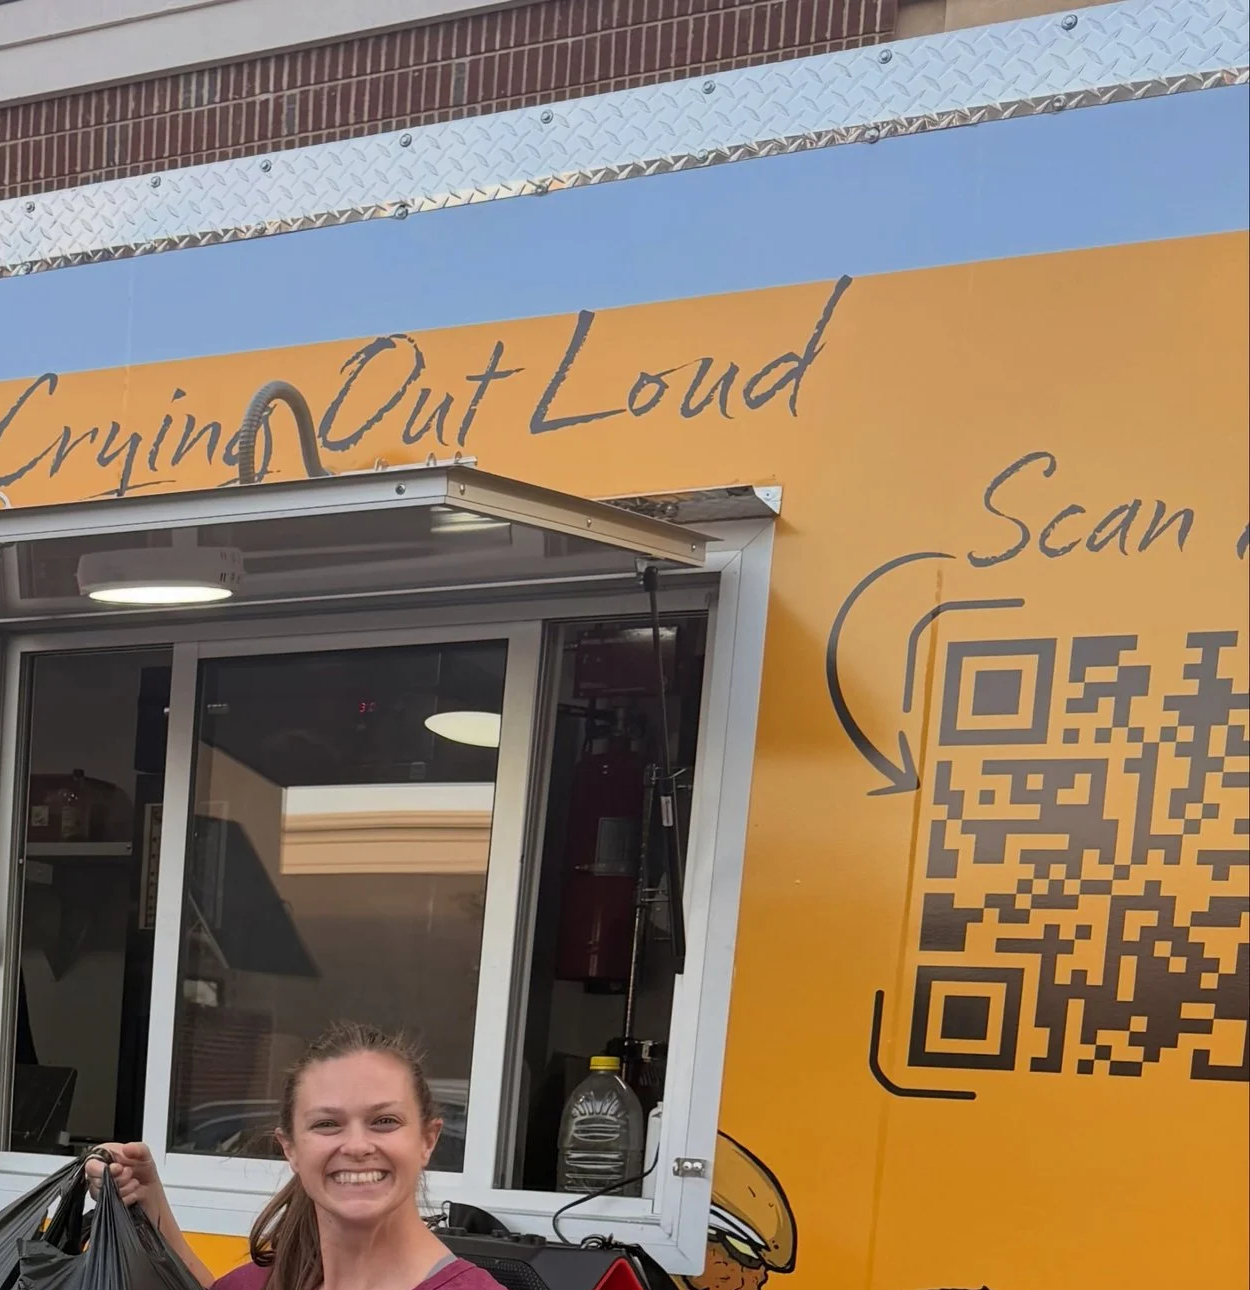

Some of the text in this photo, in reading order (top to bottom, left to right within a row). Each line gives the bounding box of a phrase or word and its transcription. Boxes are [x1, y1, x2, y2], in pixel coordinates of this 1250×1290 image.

[318, 333, 526, 451] Out
[529, 274, 852, 435] Loud
[966, 450, 1196, 568] Scan
